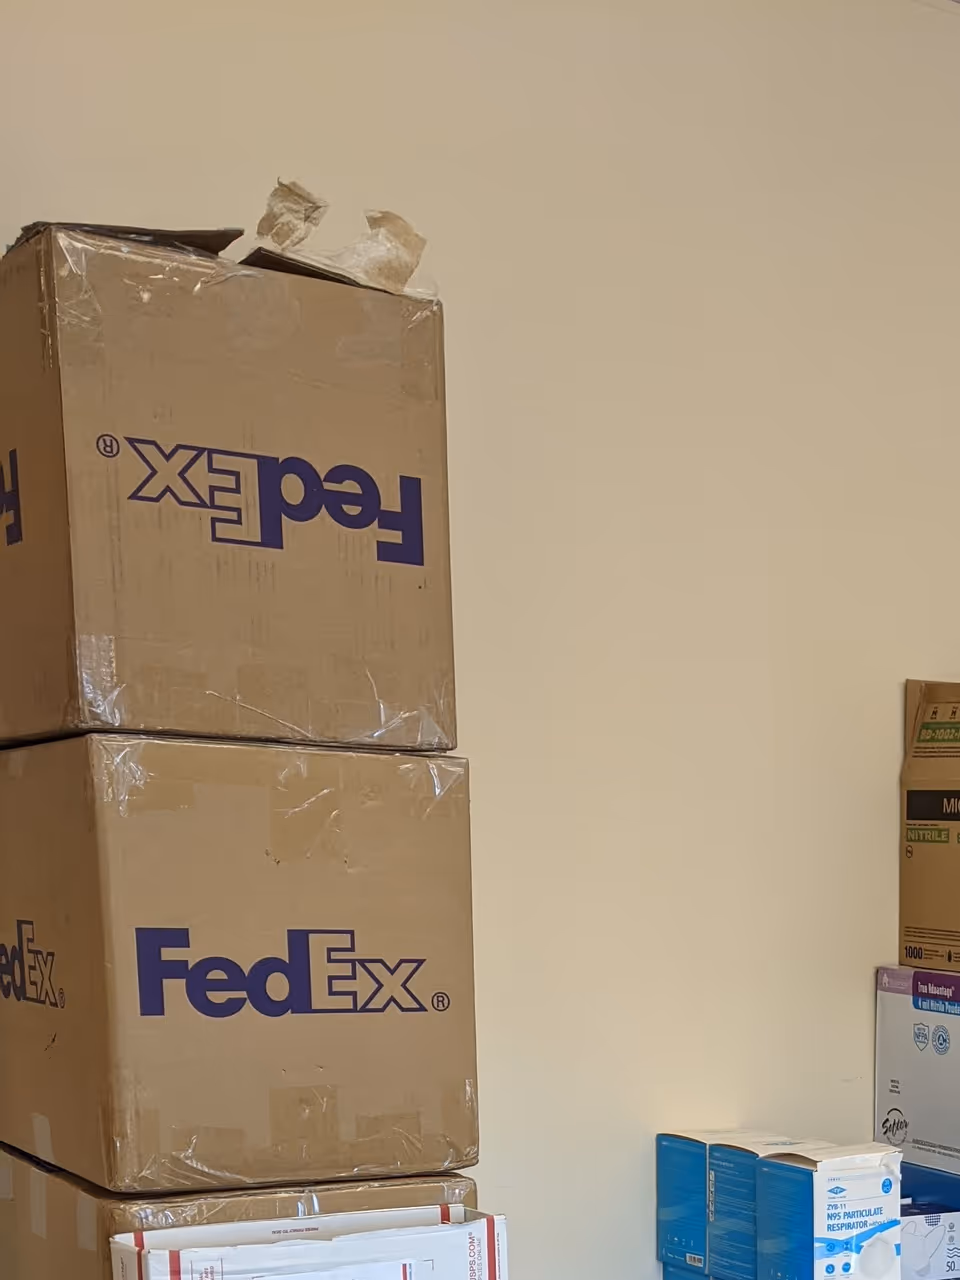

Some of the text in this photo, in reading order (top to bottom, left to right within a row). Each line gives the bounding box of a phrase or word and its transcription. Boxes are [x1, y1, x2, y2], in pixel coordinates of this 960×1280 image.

[907, 829, 949, 842] NITRILE
[904, 945, 923, 960] 1000
[0, 919, 59, 1008] edEx
[135, 927, 429, 1018] FedEx
[826, 1206, 884, 1222] N95 PARTICULATE
[826, 1219, 869, 1232] RESPIRATOR
[945, 1261, 956, 1272] 50
